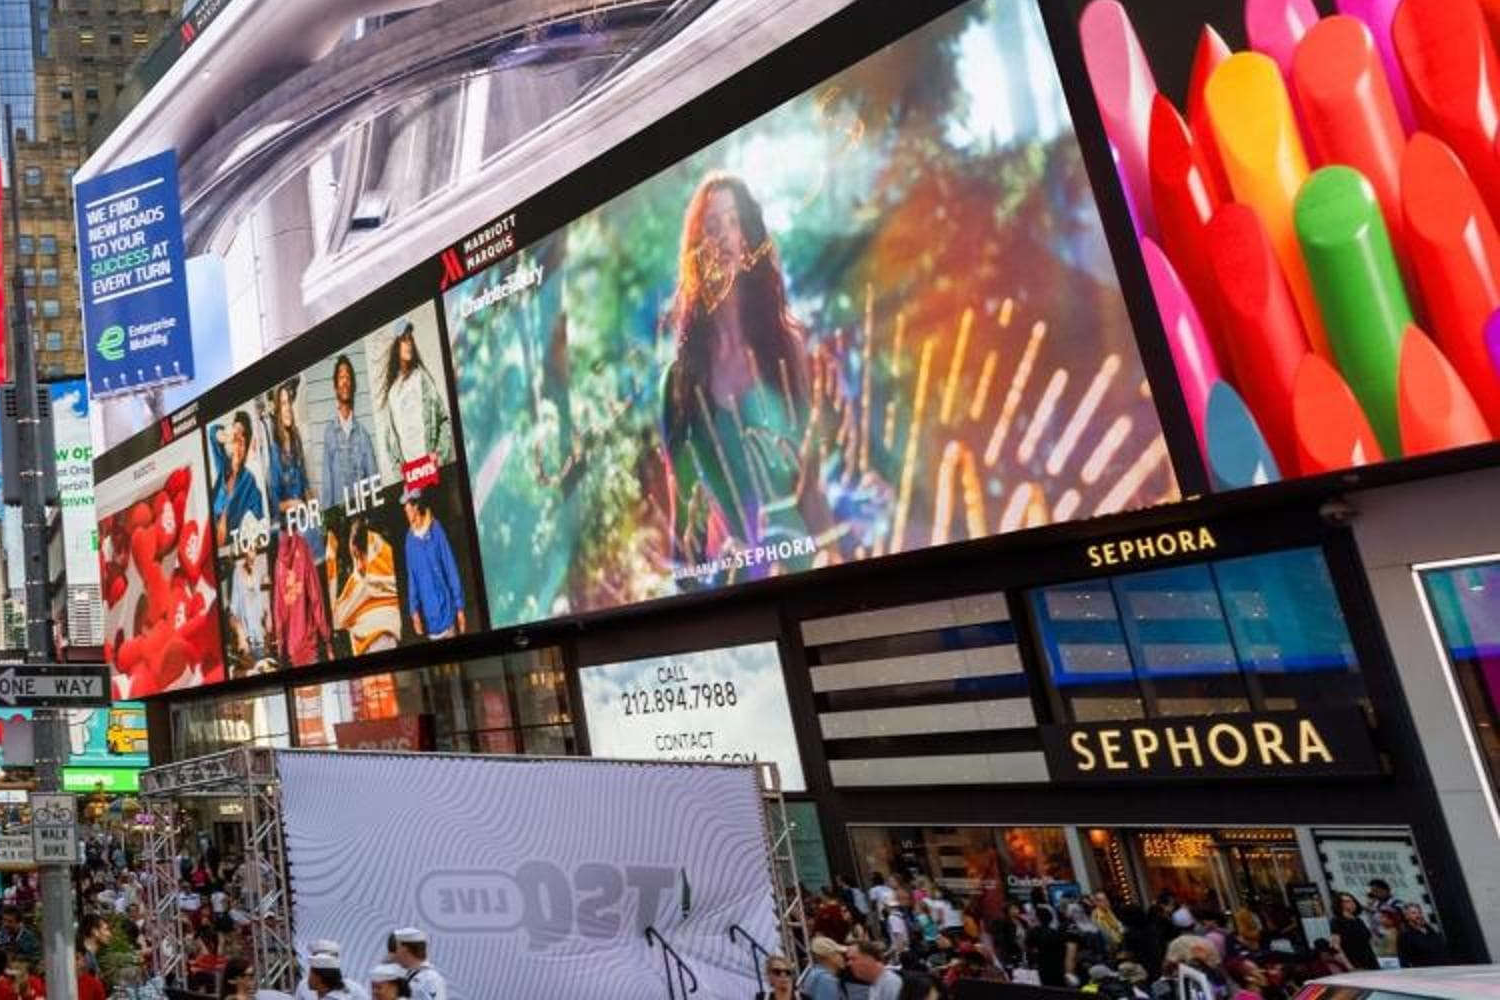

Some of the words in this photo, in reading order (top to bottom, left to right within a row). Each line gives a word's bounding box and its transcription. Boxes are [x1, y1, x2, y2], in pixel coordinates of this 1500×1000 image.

[86, 206, 108, 226] WE
[108, 196, 140, 219] FIND
[88, 223, 117, 243] NEW
[119, 204, 165, 233] ROADS
[90, 242, 109, 260] TO
[109, 230, 146, 255] YOUR
[463, 212, 517, 254] MARRIOTT
[90, 247, 150, 279] SUCCESS
[151, 240, 170, 260] AT
[466, 234, 515, 271] MARQUIS
[92, 274, 133, 296] EVERY
[135, 259, 172, 283] TURN
[128, 316, 178, 338] Enterprise
[286, 497, 324, 536] FOR
[343, 472, 385, 518] LIFE
[734, 535, 817, 569] SEPHORA
[1087, 526, 1217, 568] SEPHORA
[0, 678, 37, 696] ONE
[55, 678, 94, 696] WAY
[656, 665, 689, 684] CALL
[621, 681, 739, 716] 212.894.7988
[655, 731, 714, 752] CONTACT
[1070, 719, 1334, 772] SEPHORA
